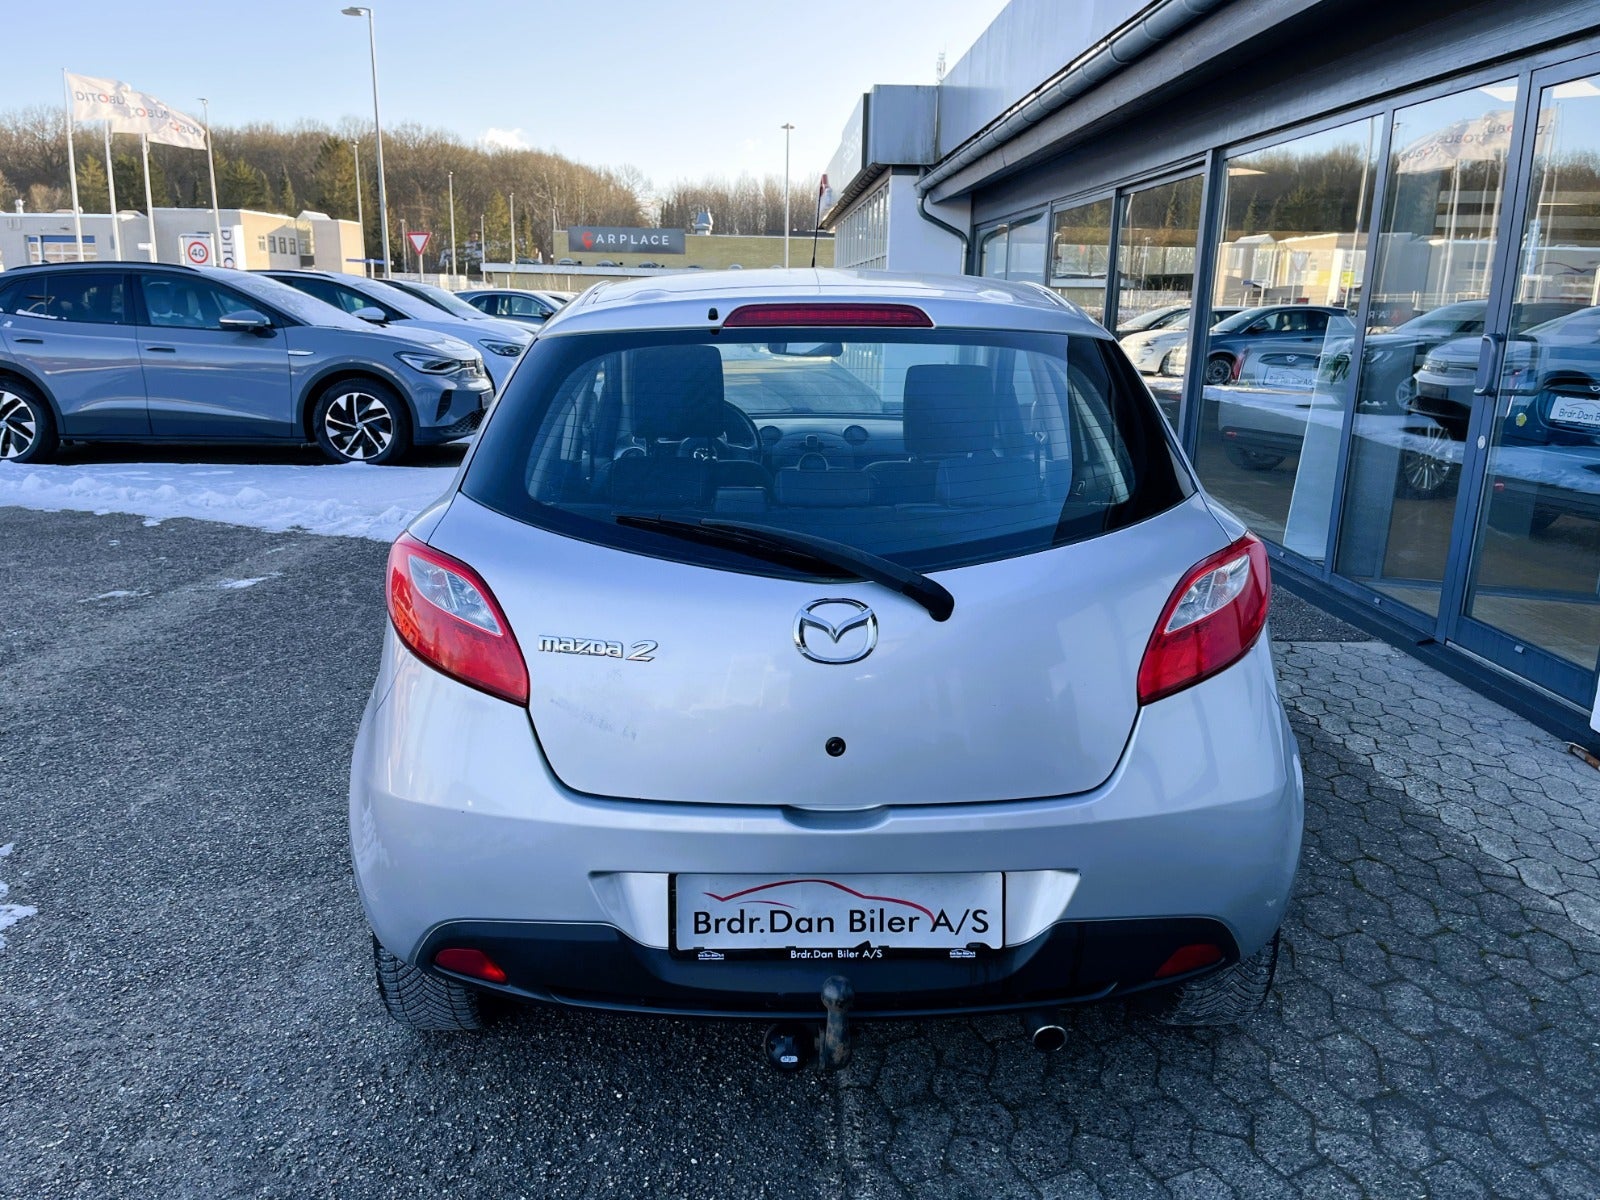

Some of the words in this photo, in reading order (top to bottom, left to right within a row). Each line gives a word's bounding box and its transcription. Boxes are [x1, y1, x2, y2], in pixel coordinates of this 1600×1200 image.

[75, 91, 126, 105] DITOBU
[191, 248, 205, 258] 40
[221, 230, 235, 269] DITO
[538, 634, 624, 658] mazda
[625, 639, 659, 662] 2
[693, 908, 835, 935] Brdr.Dan
[849, 908, 920, 933] Biler
[930, 908, 990, 936] A/S
[790, 949, 834, 959] Brdr.Dan
[837, 949, 860, 959] Biler
[862, 949, 883, 960] A/S
